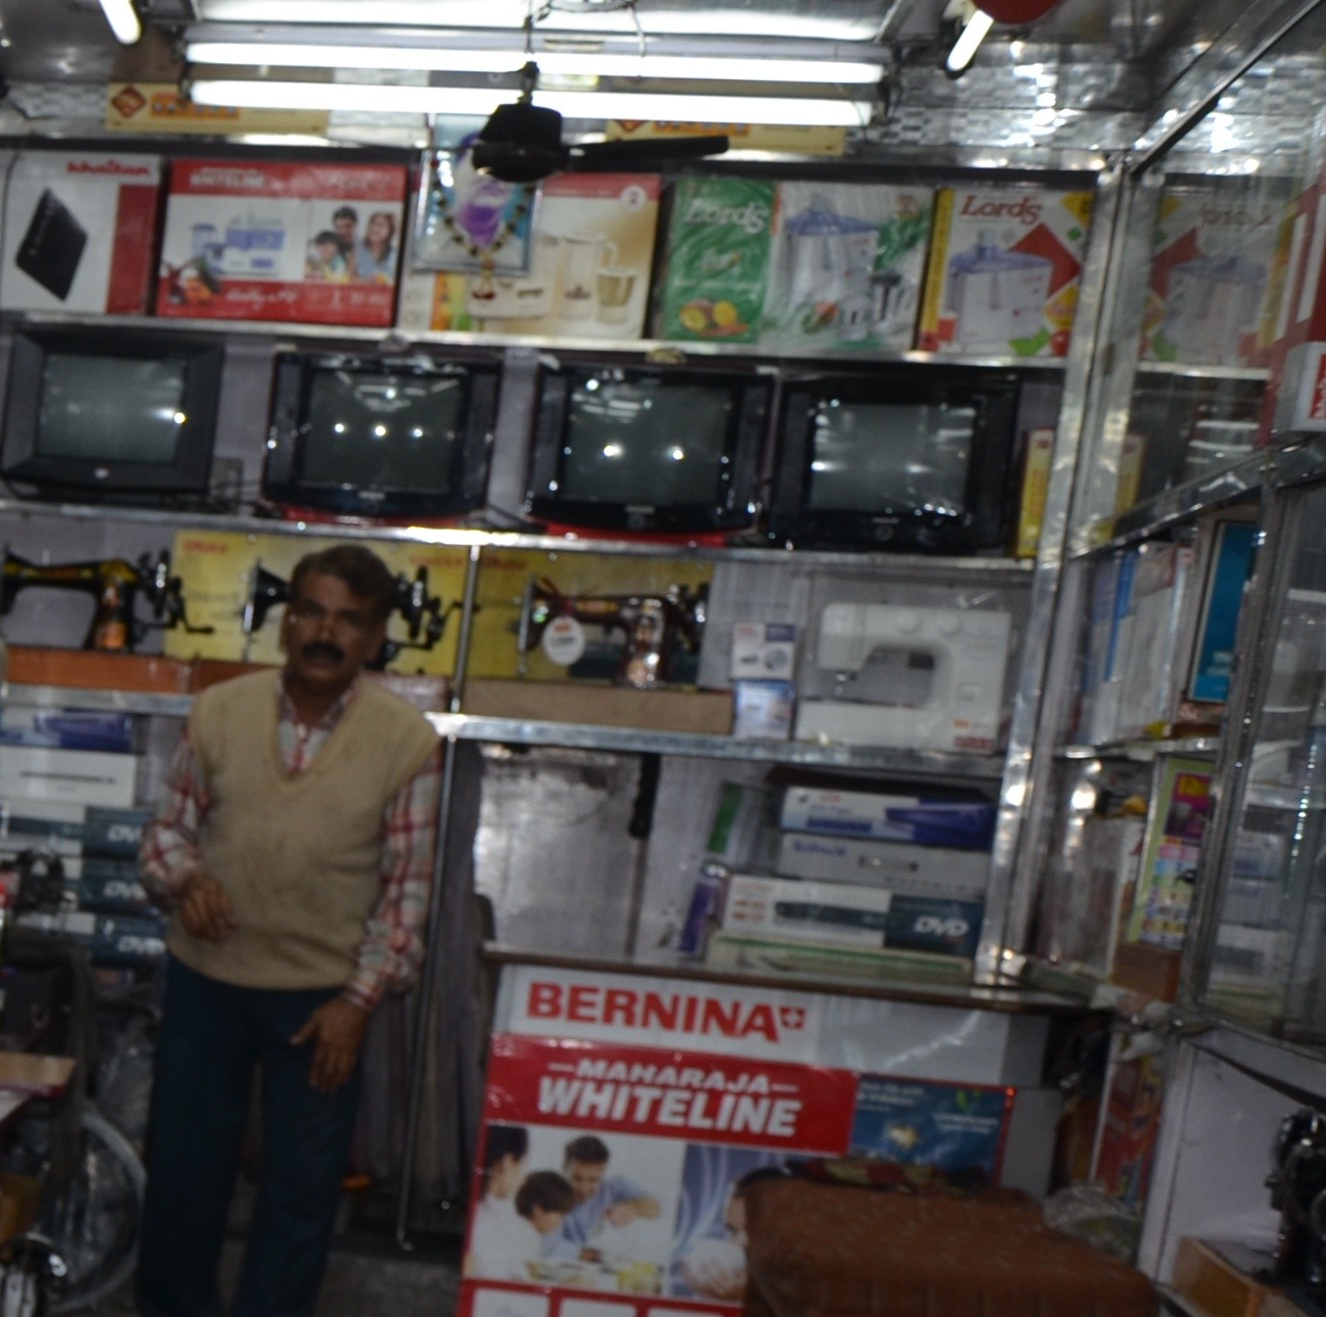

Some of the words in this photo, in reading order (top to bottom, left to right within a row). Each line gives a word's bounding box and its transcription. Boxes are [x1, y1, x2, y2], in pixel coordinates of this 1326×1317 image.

[526, 981, 781, 1043] BERNINA
[574, 1057, 770, 1094] MAHARAJA
[538, 1076, 804, 1138] WHITELINE
